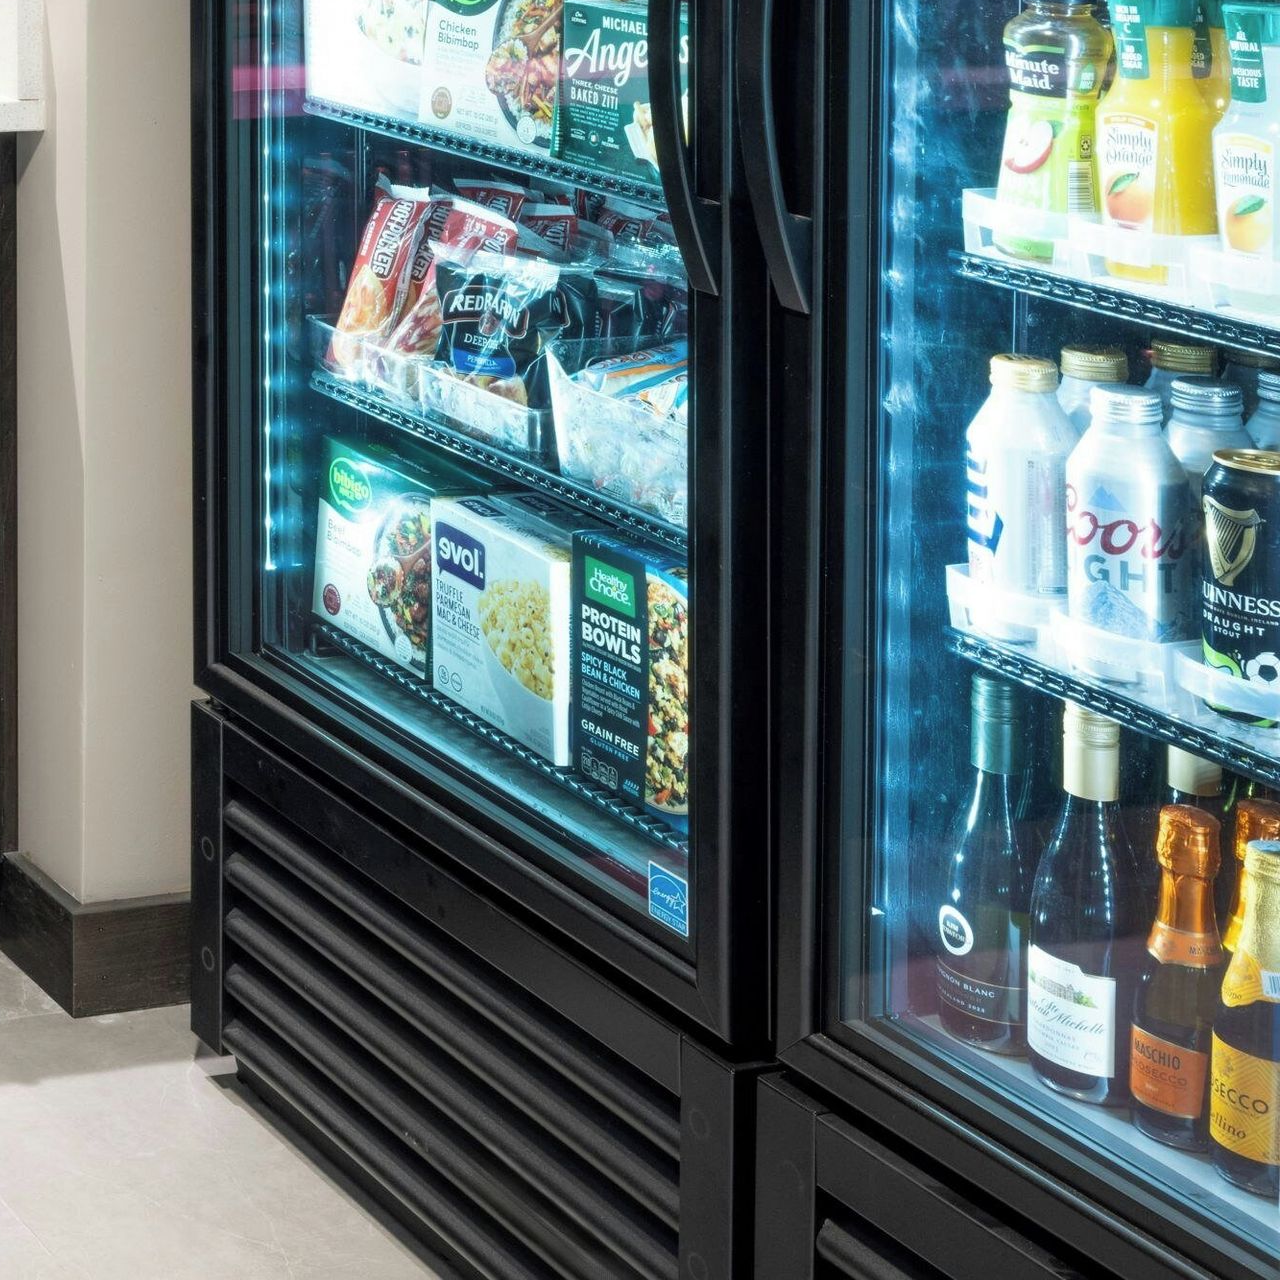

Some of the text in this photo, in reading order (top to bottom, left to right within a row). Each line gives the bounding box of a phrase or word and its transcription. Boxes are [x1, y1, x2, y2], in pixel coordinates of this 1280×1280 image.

[437, 32, 479, 51] Bibimbap
[439, 20, 477, 37] Chicken
[1005, 50, 1059, 75] Minute
[572, 78, 618, 95] THREE CHEESE
[1010, 68, 1050, 90] Maid
[1237, 77, 1259, 89] TASTE
[570, 86, 618, 110] BAKED ZITI
[593, 567, 628, 592] Healthy
[1083, 554, 1178, 595] GHT
[436, 578, 464, 603] TRUFFLE
[589, 576, 630, 604] Choice
[1203, 580, 1280, 617] UINNESS
[436, 591, 471, 620] PARMESAN
[436, 605, 480, 640] MAC & CHEESE
[581, 603, 641, 644] PROTEIN
[1203, 609, 1265, 636] DRAUGHT
[1214, 626, 1240, 639] STOUT
[581, 621, 641, 665] BOWLS
[581, 651, 627, 680] SPICY BLACK
[581, 663, 640, 699] BEAN & CHICKEN
[581, 719, 639, 756] GRAIN FREE
[963, 984, 995, 998] BLANC
[1135, 1037, 1181, 1071] MASCHIO
